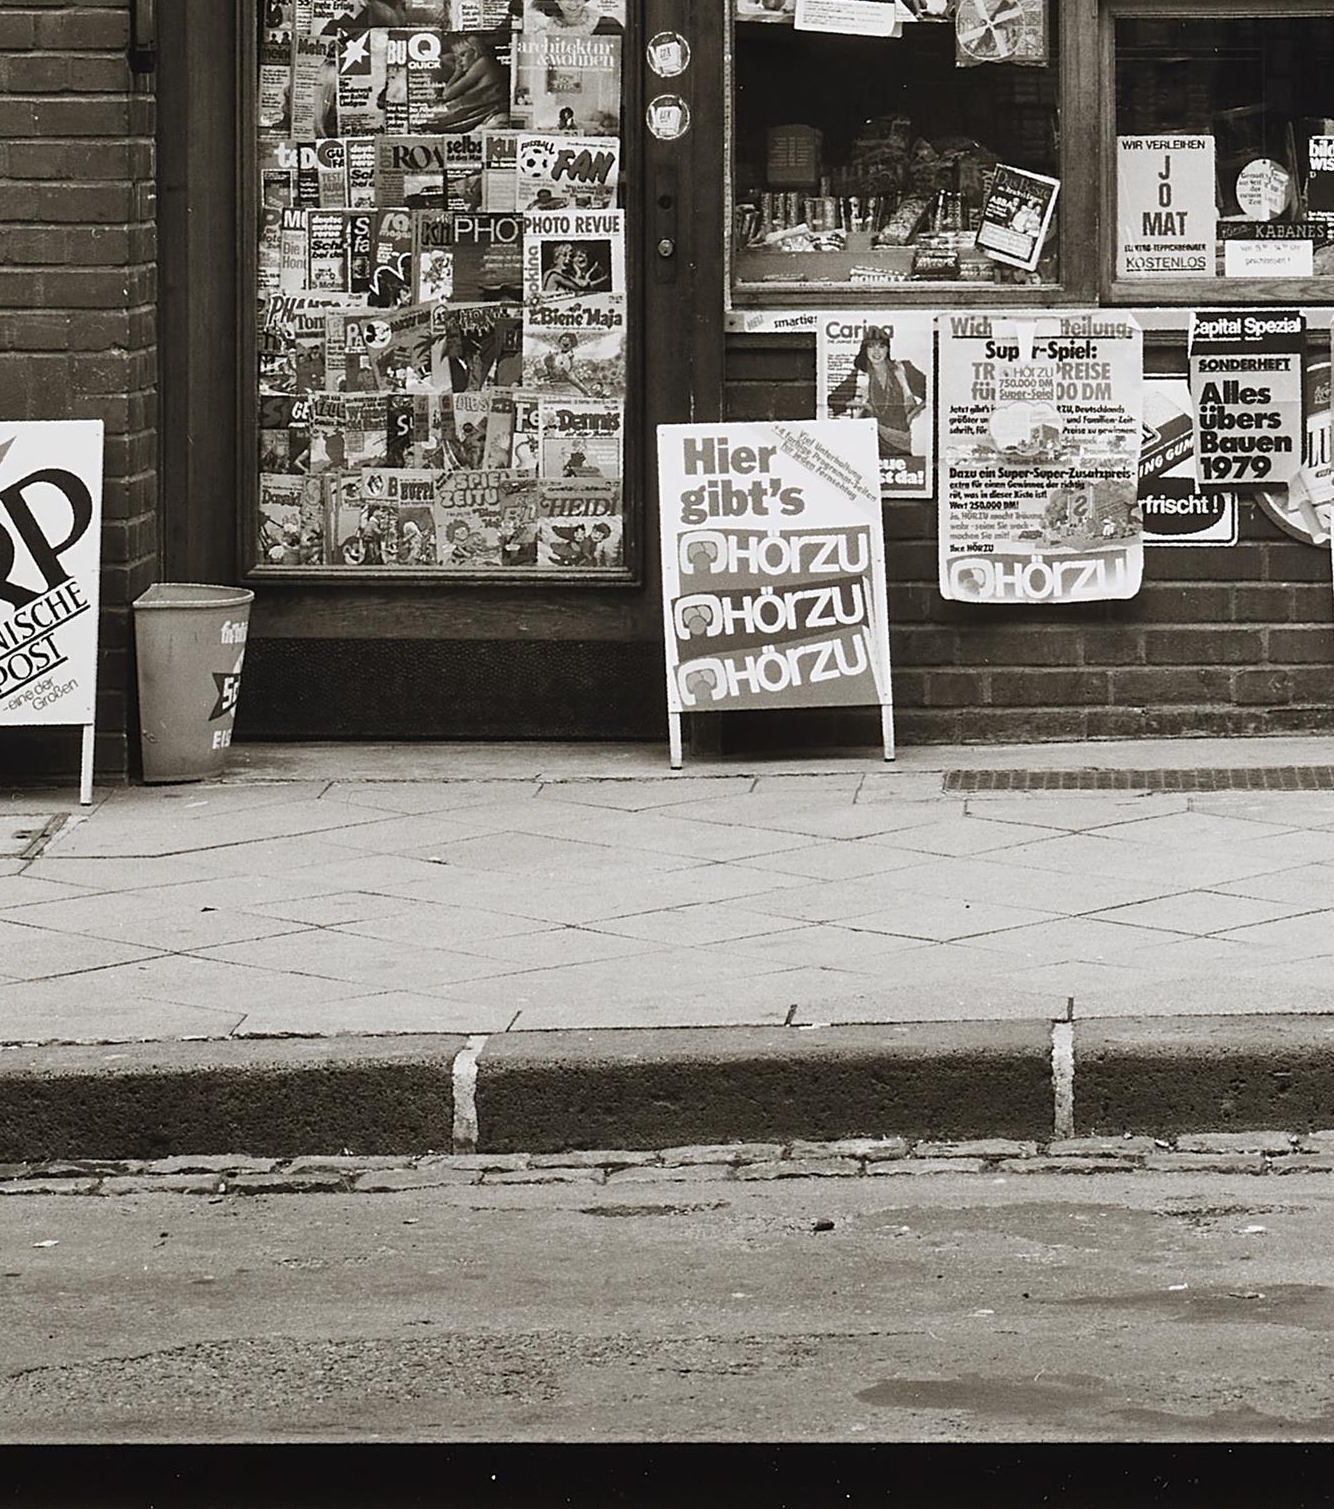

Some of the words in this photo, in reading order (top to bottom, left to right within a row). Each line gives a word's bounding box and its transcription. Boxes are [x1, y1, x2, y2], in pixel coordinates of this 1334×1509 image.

[408, 33, 441, 62] Q
[517, 38, 614, 53] architektur
[408, 61, 441, 69] QUICK
[1122, 141, 1143, 149] WIR
[1146, 140, 1205, 149] VERLEIHEN
[551, 149, 616, 184] FAN
[1158, 155, 1171, 180] J
[1158, 183, 1172, 207] O
[523, 217, 570, 233] PHOTO
[575, 216, 619, 232] REVUE
[1142, 212, 1188, 237] MAT
[1126, 256, 1207, 269] KOSTENLOS
[540, 305, 584, 326] Biene
[583, 307, 622, 330] Maja
[1244, 314, 1301, 335] Spezial
[825, 319, 894, 339] Carina
[1198, 358, 1290, 373] SONDERHEFT
[1000, 379, 1036, 388] 750.000
[1039, 379, 1053, 387] DM
[1000, 389, 1053, 399] Super-Spiel
[1082, 383, 1111, 400] DM
[1199, 379, 1271, 405] Alles
[556, 410, 620, 431] Dennis
[949, 415, 978, 424] größter
[1199, 404, 1282, 430] übers
[950, 426, 974, 435] schrift,
[976, 426, 987, 434] für
[785, 431, 812, 455] farbige
[1200, 431, 1292, 454] Bauen
[683, 437, 777, 476] Hier
[799, 430, 816, 446] Viel
[814, 442, 863, 481] Unterhaltung
[793, 451, 816, 471] jeden
[815, 466, 857, 501] Fernsehtag
[896, 471, 924, 485] da!
[950, 468, 976, 478] Dazu
[979, 468, 996, 478] ein
[1201, 456, 1271, 480] 1979
[1061, 481, 1085, 490] richtig
[542, 494, 619, 517] HEIDI
[680, 478, 805, 525] gibt's
[32, 678, 79, 711] Großen
[34, 677, 54, 692] der
